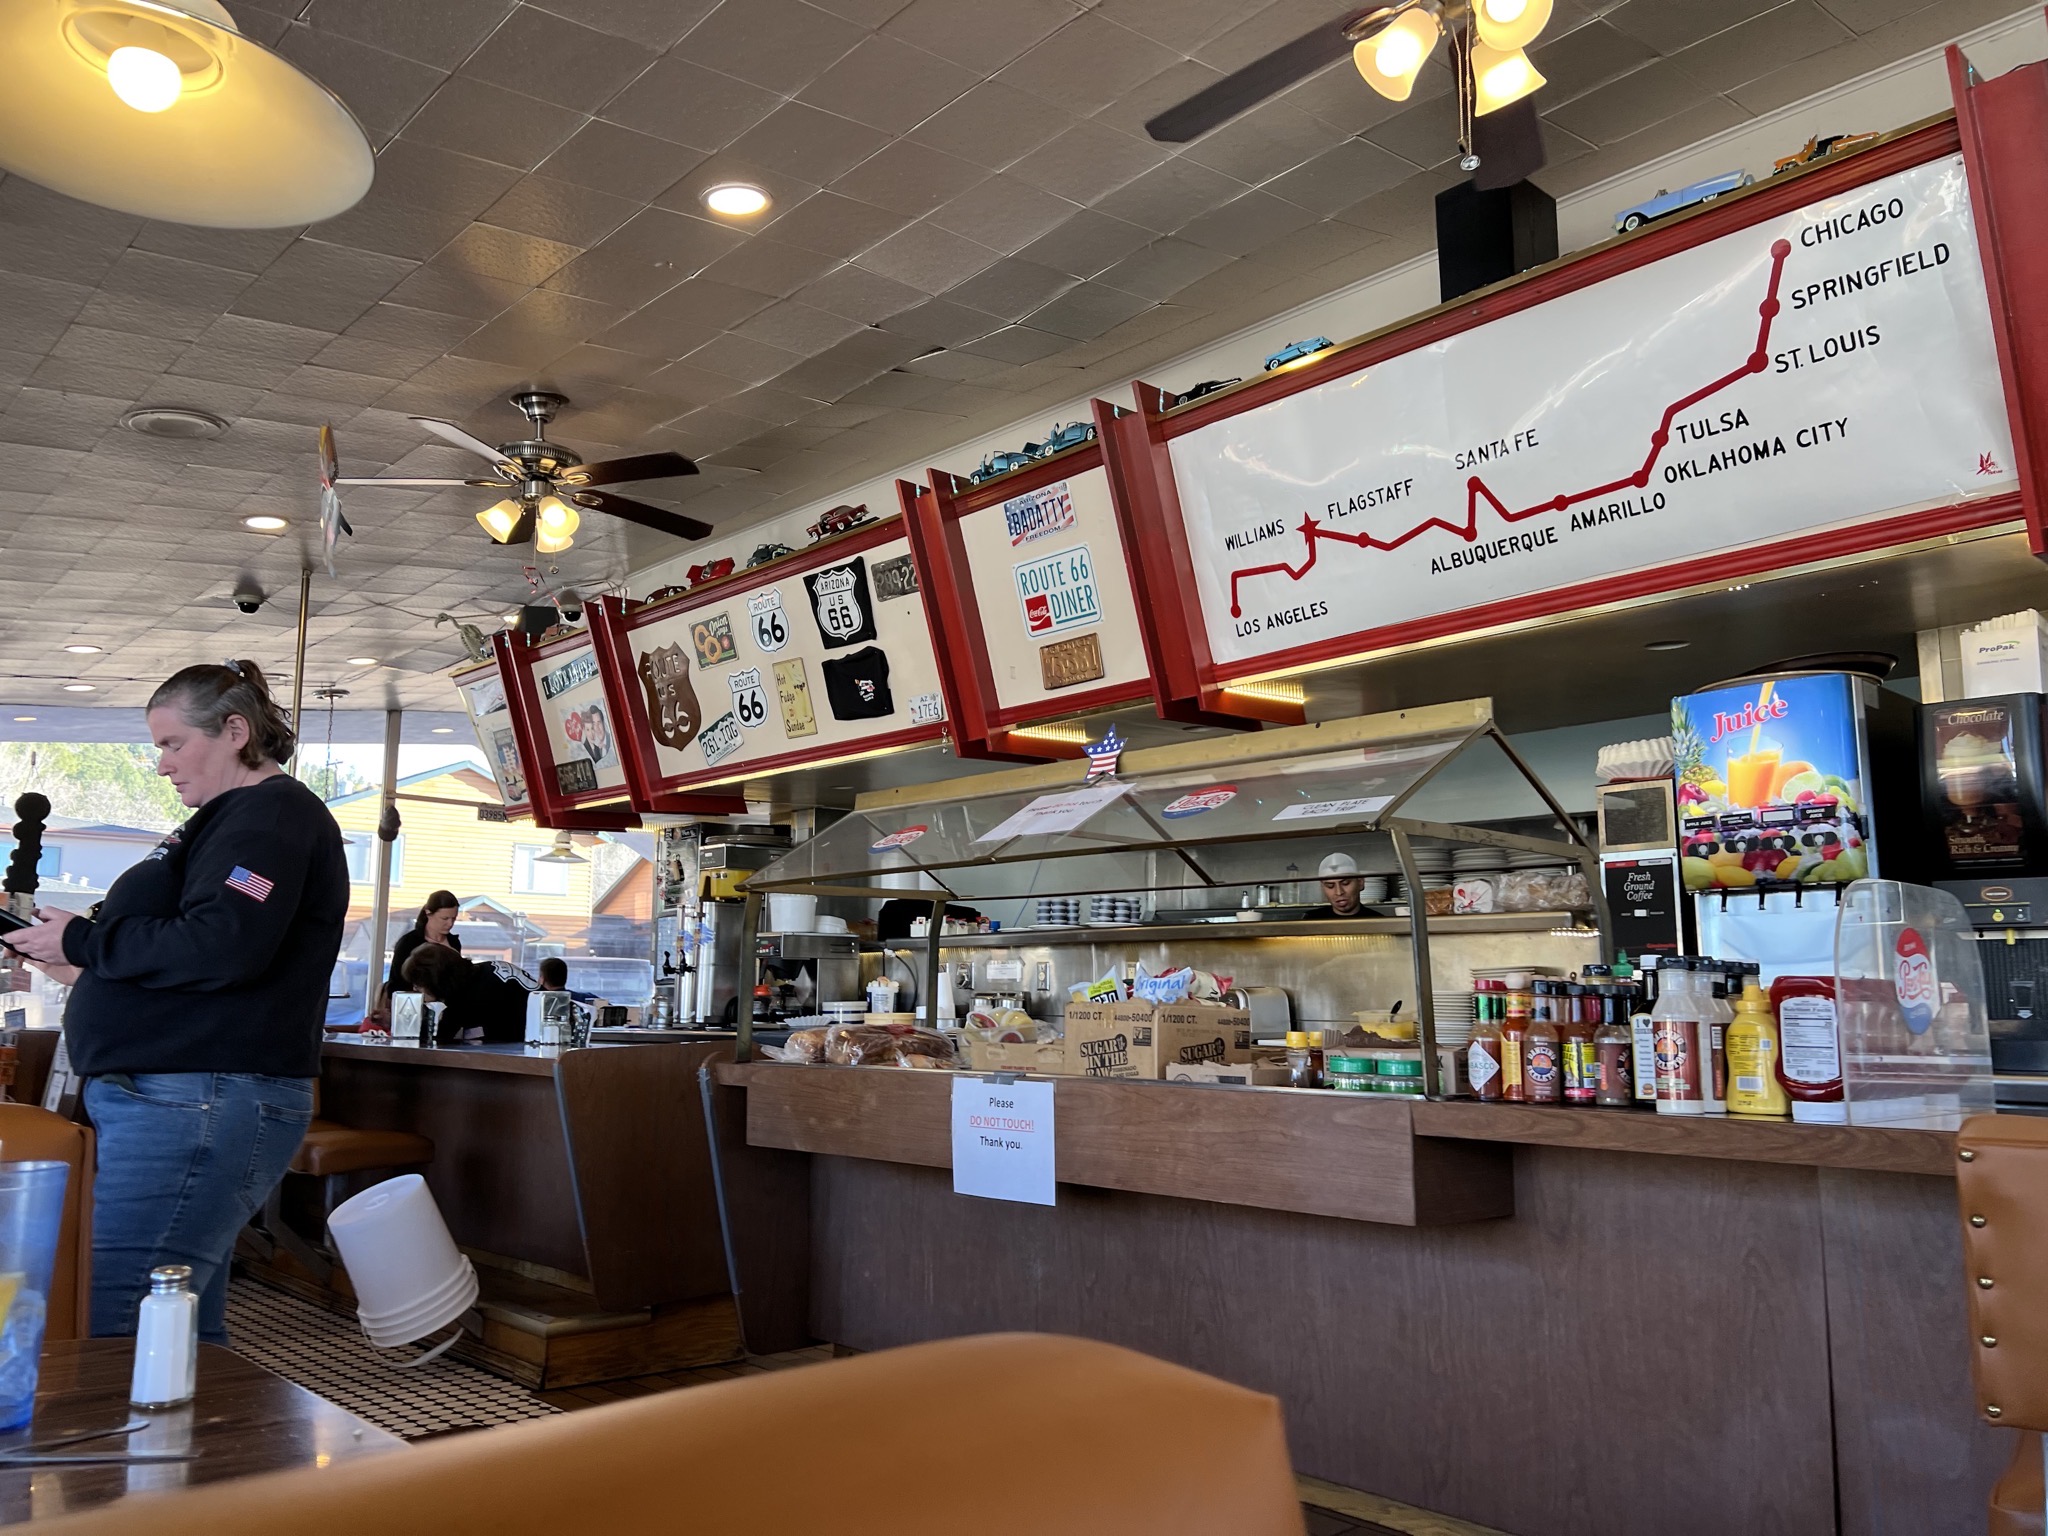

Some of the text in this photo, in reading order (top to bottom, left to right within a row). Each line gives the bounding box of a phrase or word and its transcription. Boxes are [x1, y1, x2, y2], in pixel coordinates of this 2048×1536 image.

[1801, 199, 1904, 247] CHICAGO
[1791, 243, 1950, 310] SPRINGFIELD
[1774, 325, 1881, 374] ST. LOUIS
[1675, 408, 1750, 444] TULSA
[1454, 428, 1540, 470] SANTA FE
[1664, 417, 1849, 484] OKLAHOMA CITY
[1019, 489, 1052, 506] ARIZONA
[1327, 478, 1414, 520] FLAGSTAFF
[1011, 495, 1066, 537] BADATTY
[1570, 492, 1666, 532] AMARILLO
[1025, 525, 1061, 542] FREEDOM
[1224, 518, 1285, 551] WILLIAMS
[1431, 526, 1559, 575] ALBUQUERQUE
[820, 576, 851, 592] ARIZONA
[1020, 554, 1089, 596] ROUTE 66
[753, 598, 776, 612] ROUTE
[1050, 584, 1096, 619] DINER
[709, 616, 728, 637] Onion
[827, 605, 854, 632] 66
[1235, 600, 1329, 638] LOS ANGELES
[758, 611, 785, 647] 66
[1979, 644, 2015, 654] ProPak
[543, 681, 550, 696] I
[548, 669, 570, 694] LOVE
[733, 675, 756, 689] ROUTE
[776, 673, 787, 687] Hot
[658, 683, 676, 699] US
[779, 690, 796, 705] Fudge
[920, 695, 928, 703] AZ
[738, 689, 764, 723] 66
[661, 701, 691, 739] 66
[785, 719, 806, 733] Sundae
[1710, 698, 1789, 743] Juice
[1947, 709, 2005, 726] Chocolate
[1301, 804, 1358, 816] EACH TRIP
[1303, 798, 1370, 811] CLEAN PLATE
[1973, 844, 1982, 853] &
[1627, 871, 1651, 881] Fresh
[1623, 880, 1655, 891] Ground
[1626, 890, 1653, 902] Coffee
[1135, 975, 1187, 995] Original
[1069, 1011, 1091, 1021] 1/1200
[1093, 1011, 1104, 1021] CT.
[1162, 1014, 1184, 1024] 1/1200
[1186, 1015, 1198, 1024] CT.
[1080, 1039, 1118, 1057] SUGAR
[1180, 1043, 1217, 1063] SUGAR
[1089, 1050, 1127, 1068] IN THE
[989, 1097, 1014, 1109] Please
[969, 1115, 1035, 1131] DO NOT TOUCH!
[980, 1136, 1023, 1151] Thank you.
